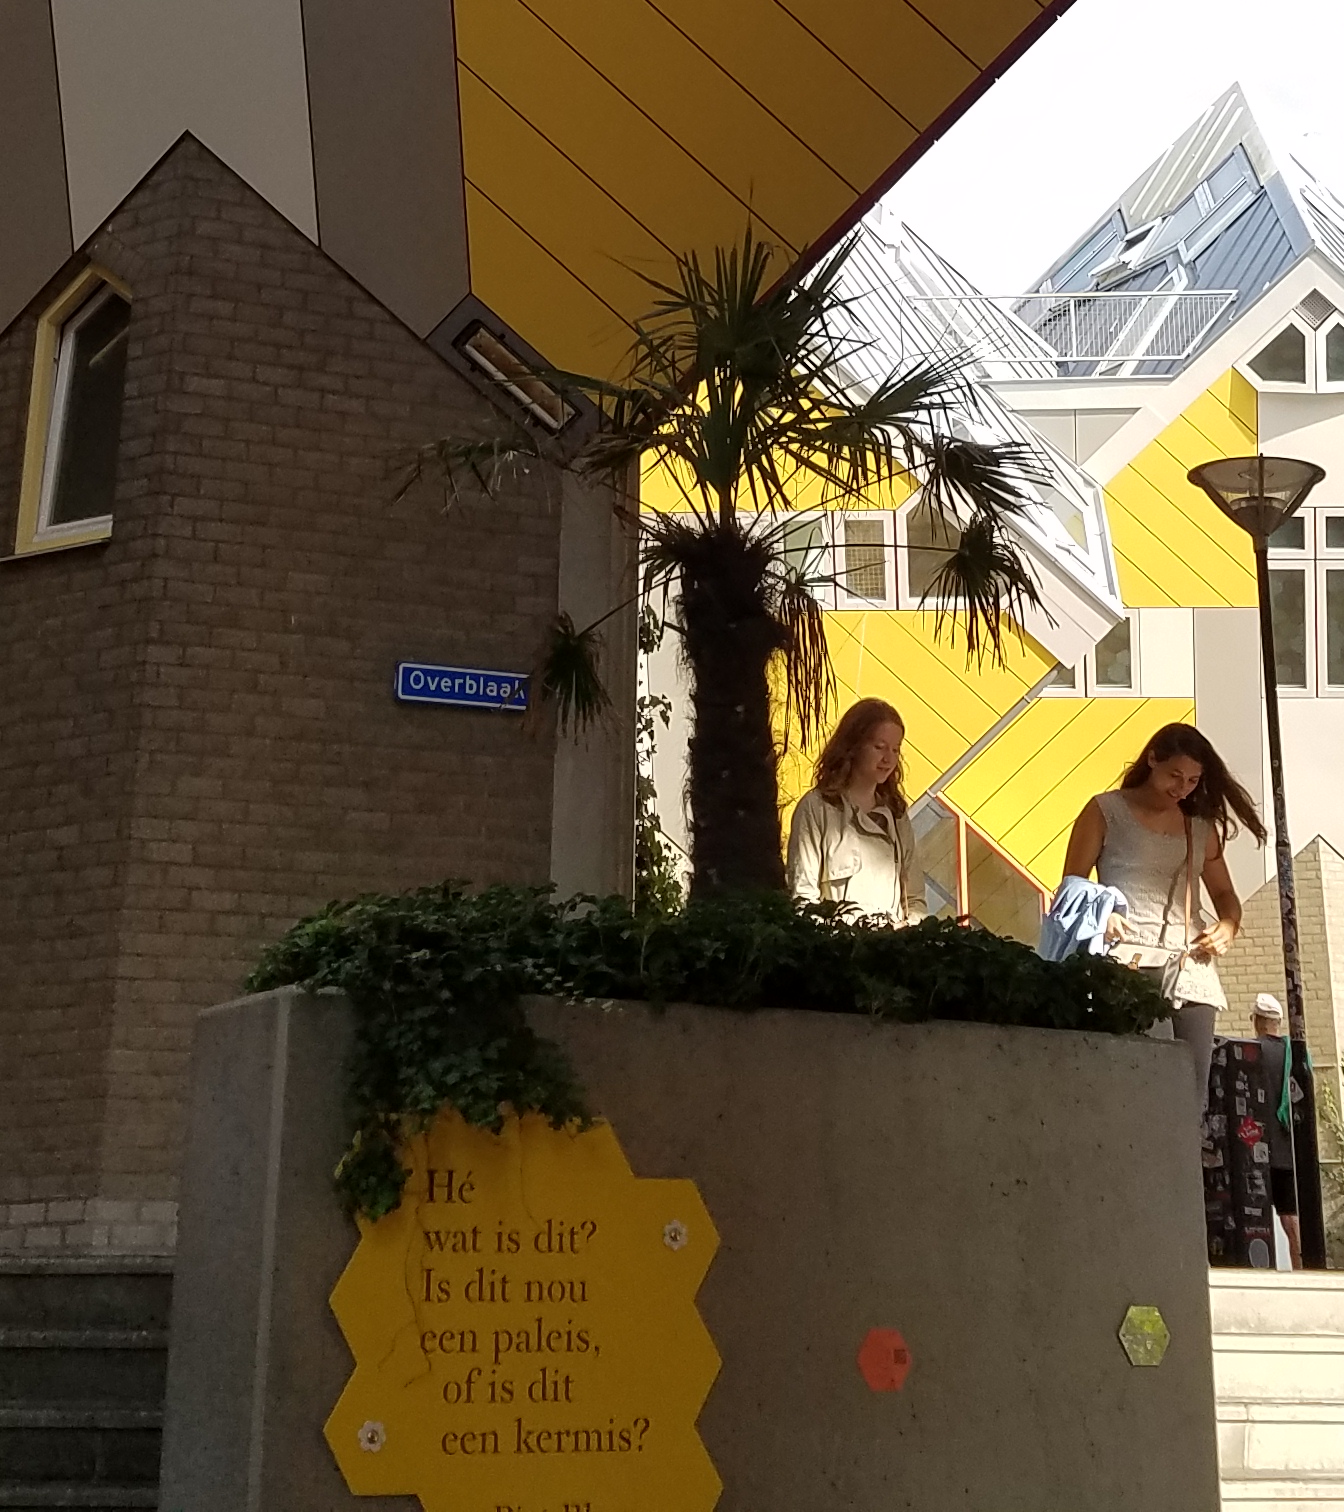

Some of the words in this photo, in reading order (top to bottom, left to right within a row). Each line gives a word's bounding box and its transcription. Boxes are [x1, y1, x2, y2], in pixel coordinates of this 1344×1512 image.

[409, 670, 525, 700] Overblaak
[425, 1168, 476, 1204] Hé
[422, 1226, 482, 1254] wat
[495, 1220, 522, 1254] is
[533, 1218, 598, 1255] dit?
[422, 1267, 452, 1303] Is
[464, 1266, 511, 1303] dit
[523, 1280, 589, 1303] nou
[419, 1330, 478, 1355] een
[492, 1316, 601, 1366] paleis,
[442, 1367, 483, 1404] of
[488, 1369, 515, 1404] is
[527, 1366, 576, 1404] dit
[441, 1430, 501, 1455] een
[513, 1417, 650, 1455] kermis?
